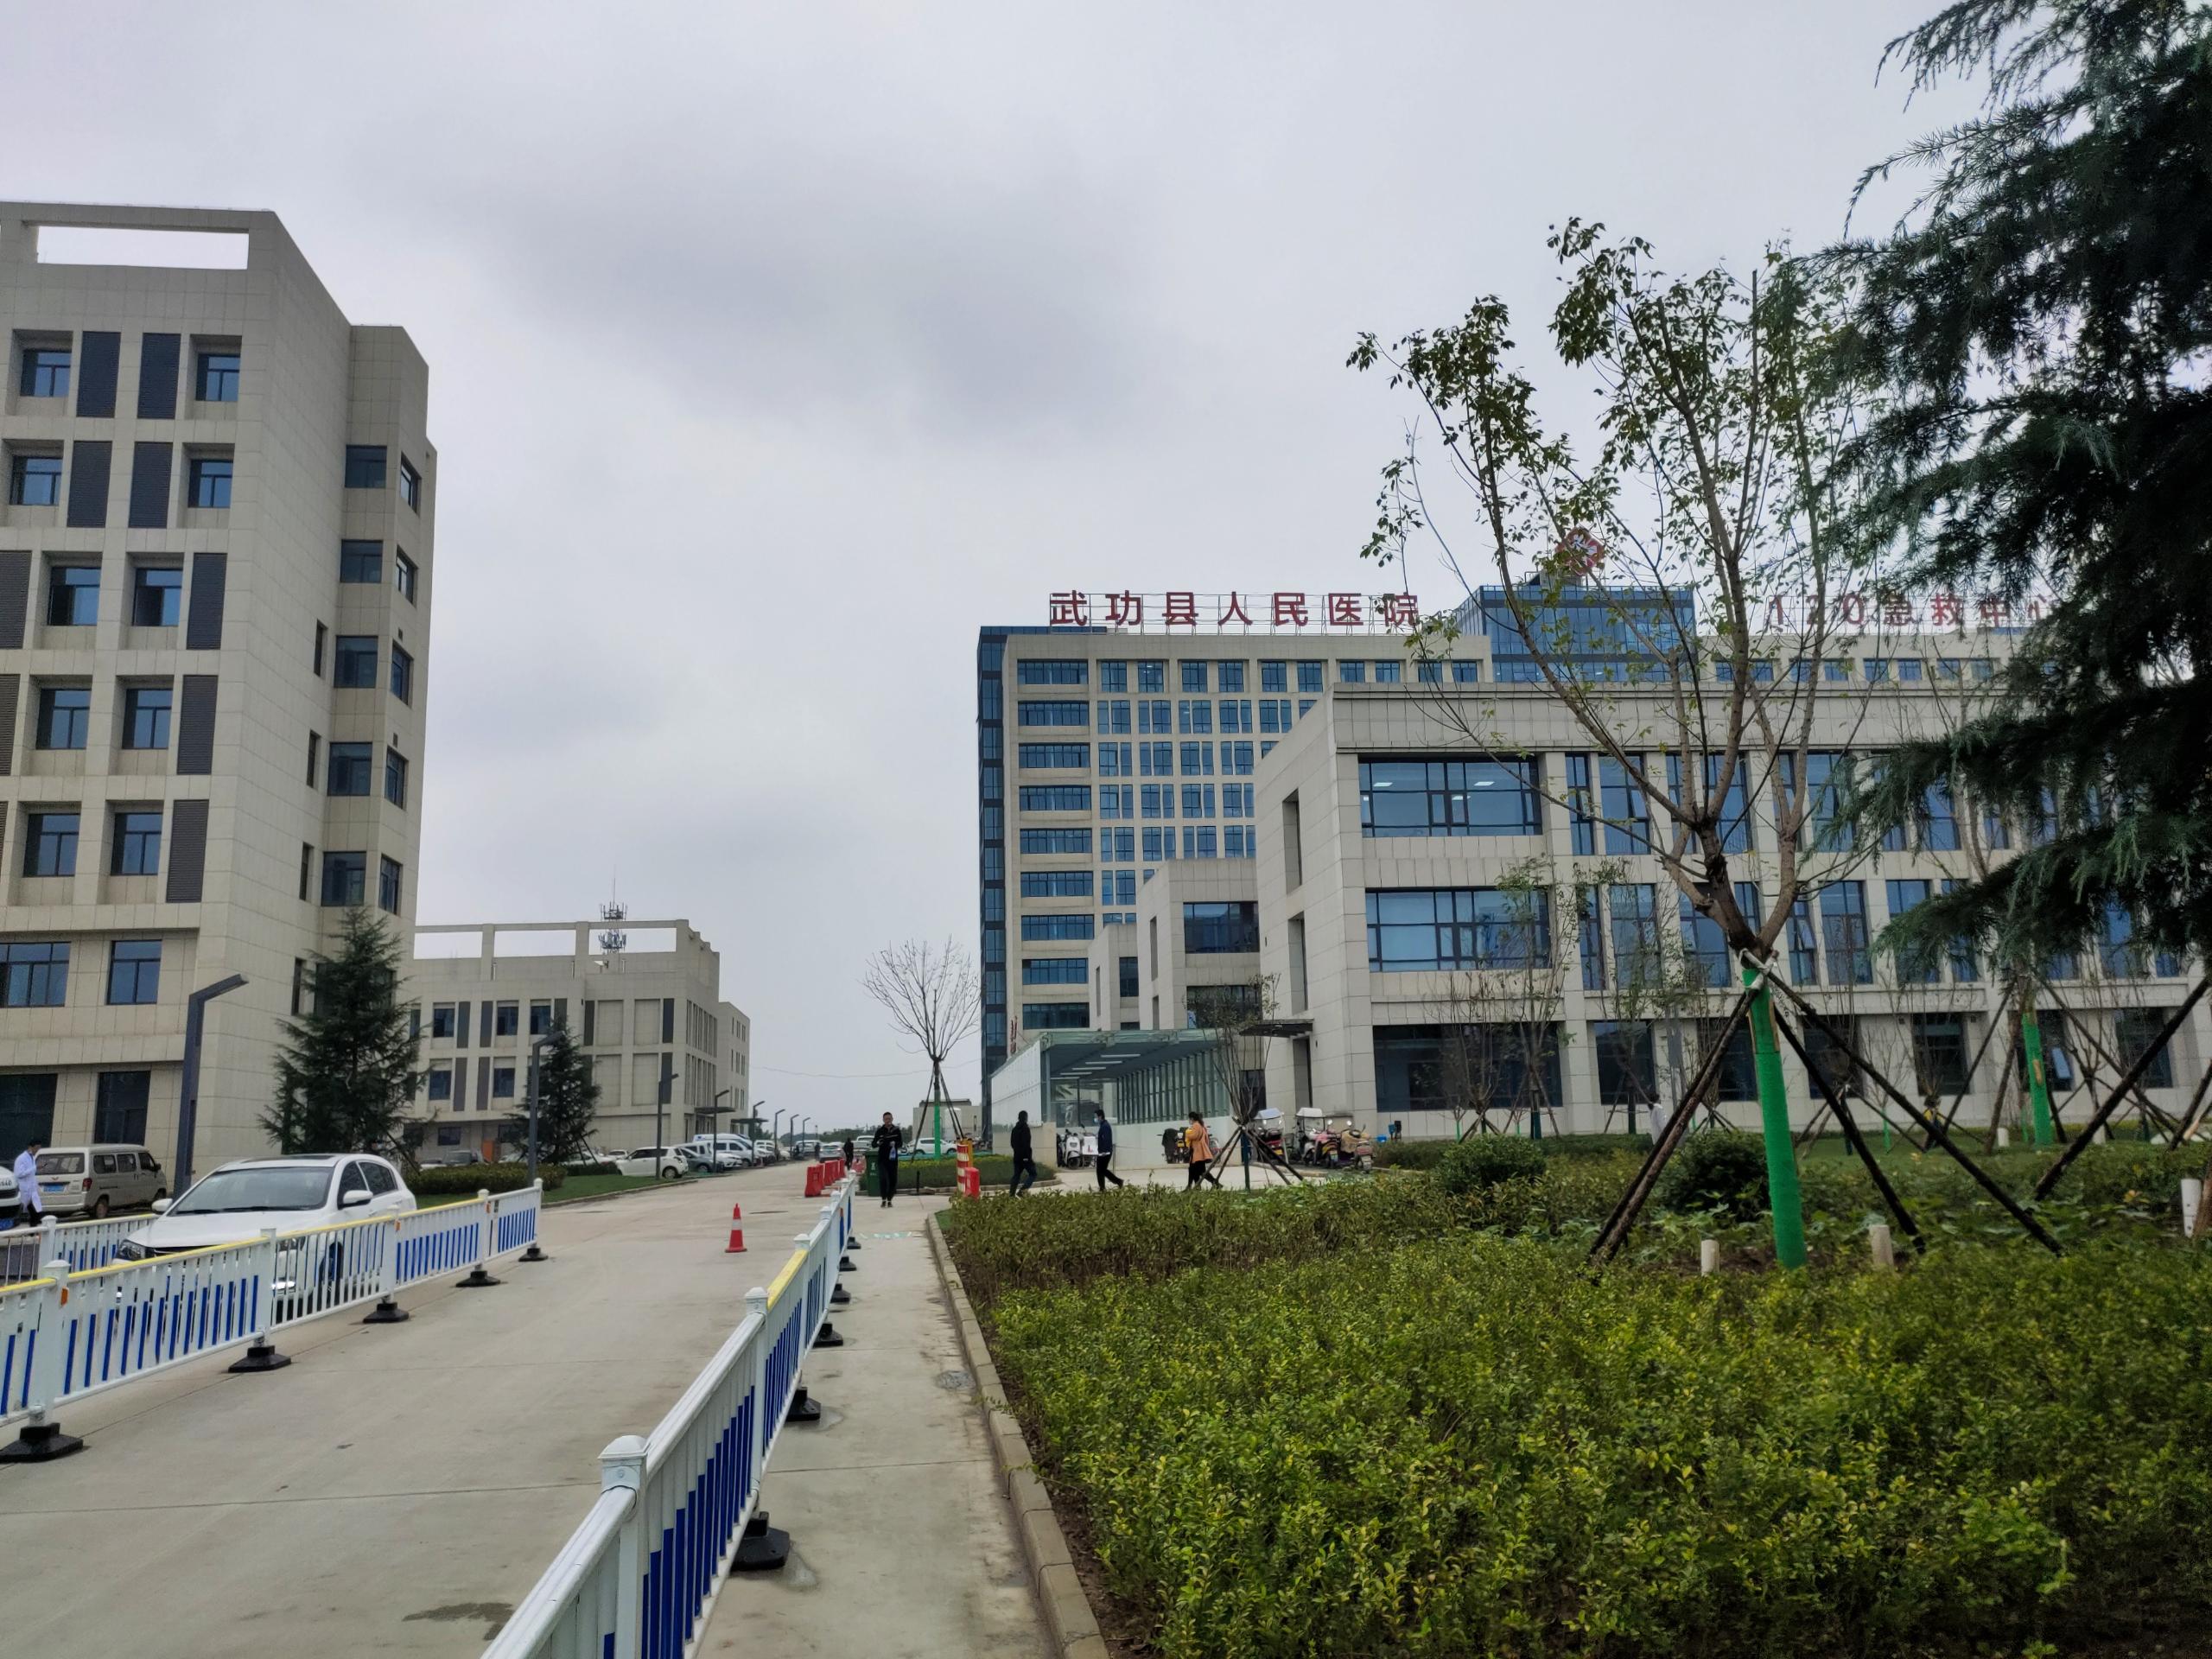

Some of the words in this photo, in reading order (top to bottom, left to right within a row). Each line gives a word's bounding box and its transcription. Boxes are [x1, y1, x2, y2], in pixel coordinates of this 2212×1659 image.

[1050, 590, 1418, 626] 武功县人民医院
